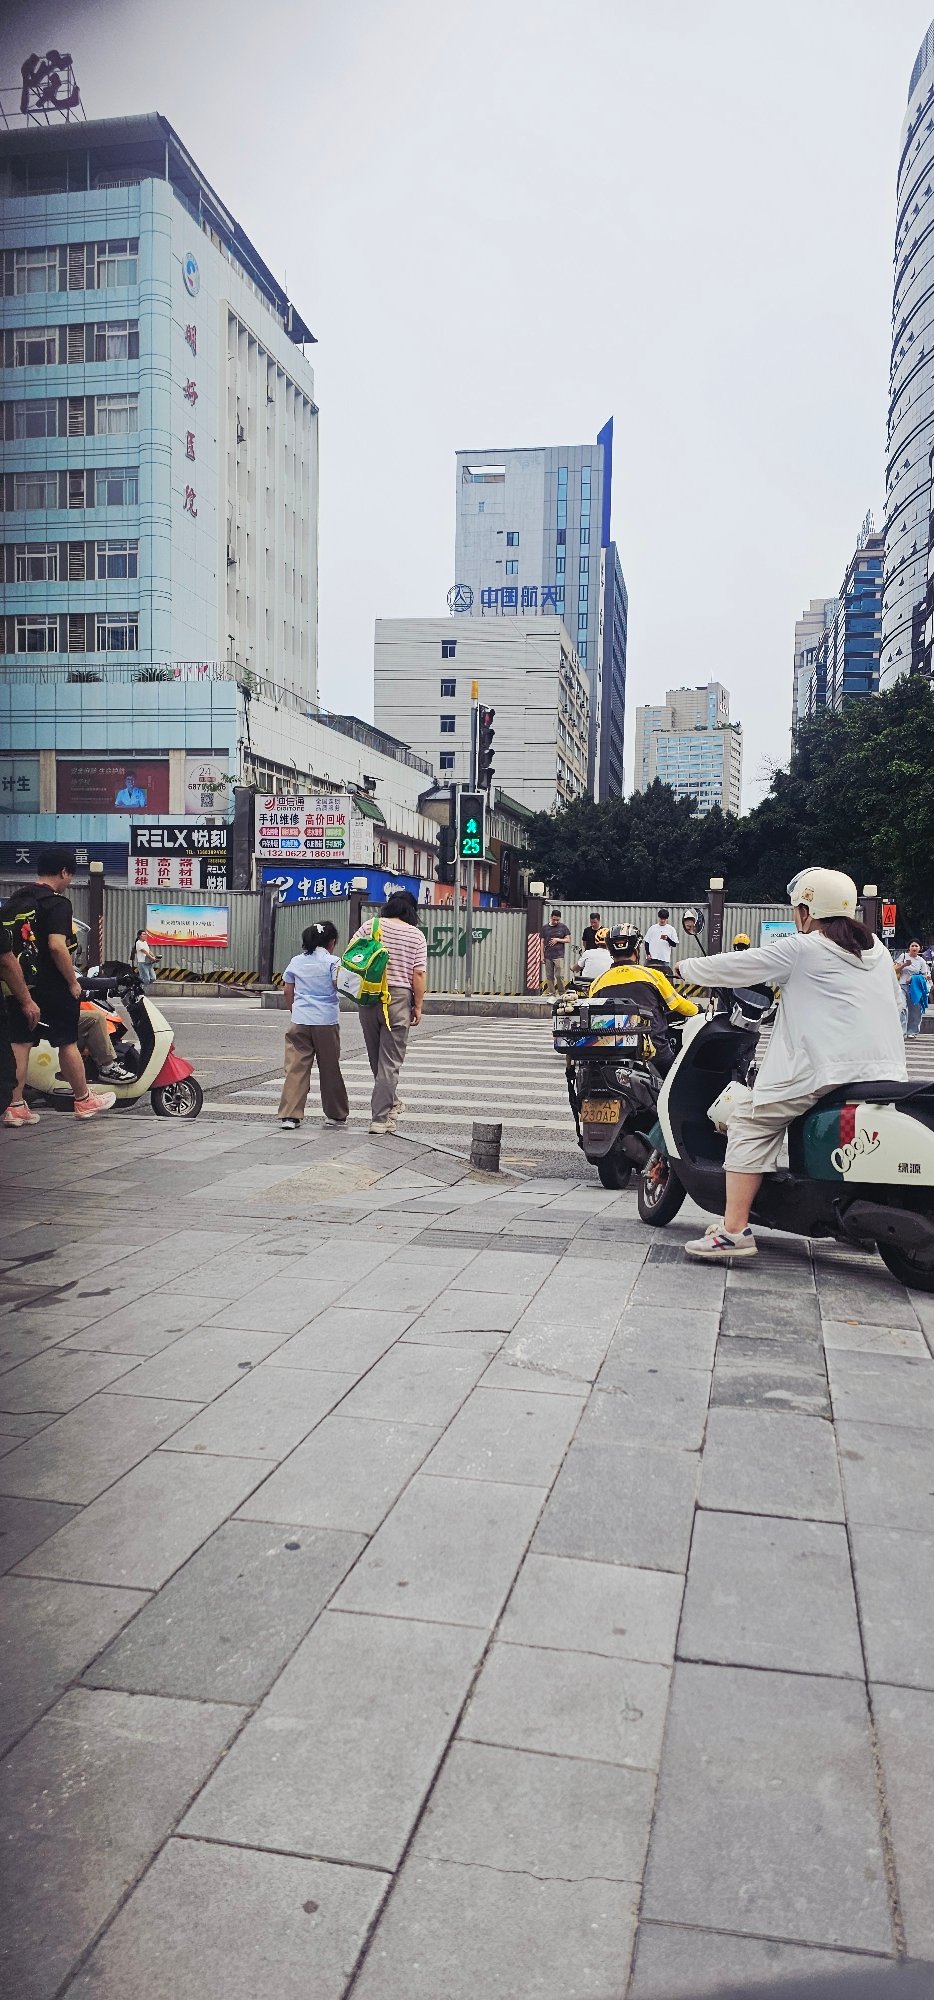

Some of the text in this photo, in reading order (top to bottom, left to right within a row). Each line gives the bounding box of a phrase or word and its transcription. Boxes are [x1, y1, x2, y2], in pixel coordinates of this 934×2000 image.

[480, 585, 558, 609] 中国航天
[2, 776, 31, 792] 计生
[259, 814, 300, 826] 手机维修
[305, 814, 346, 826] 高价回收
[137, 830, 227, 848] RELX 悦刻
[462, 838, 480, 854] 25
[285, 850, 307, 858] 0622
[310, 850, 331, 858] 1869
[207, 865, 227, 874] RELX
[897, 1162, 922, 1174] 绿源
